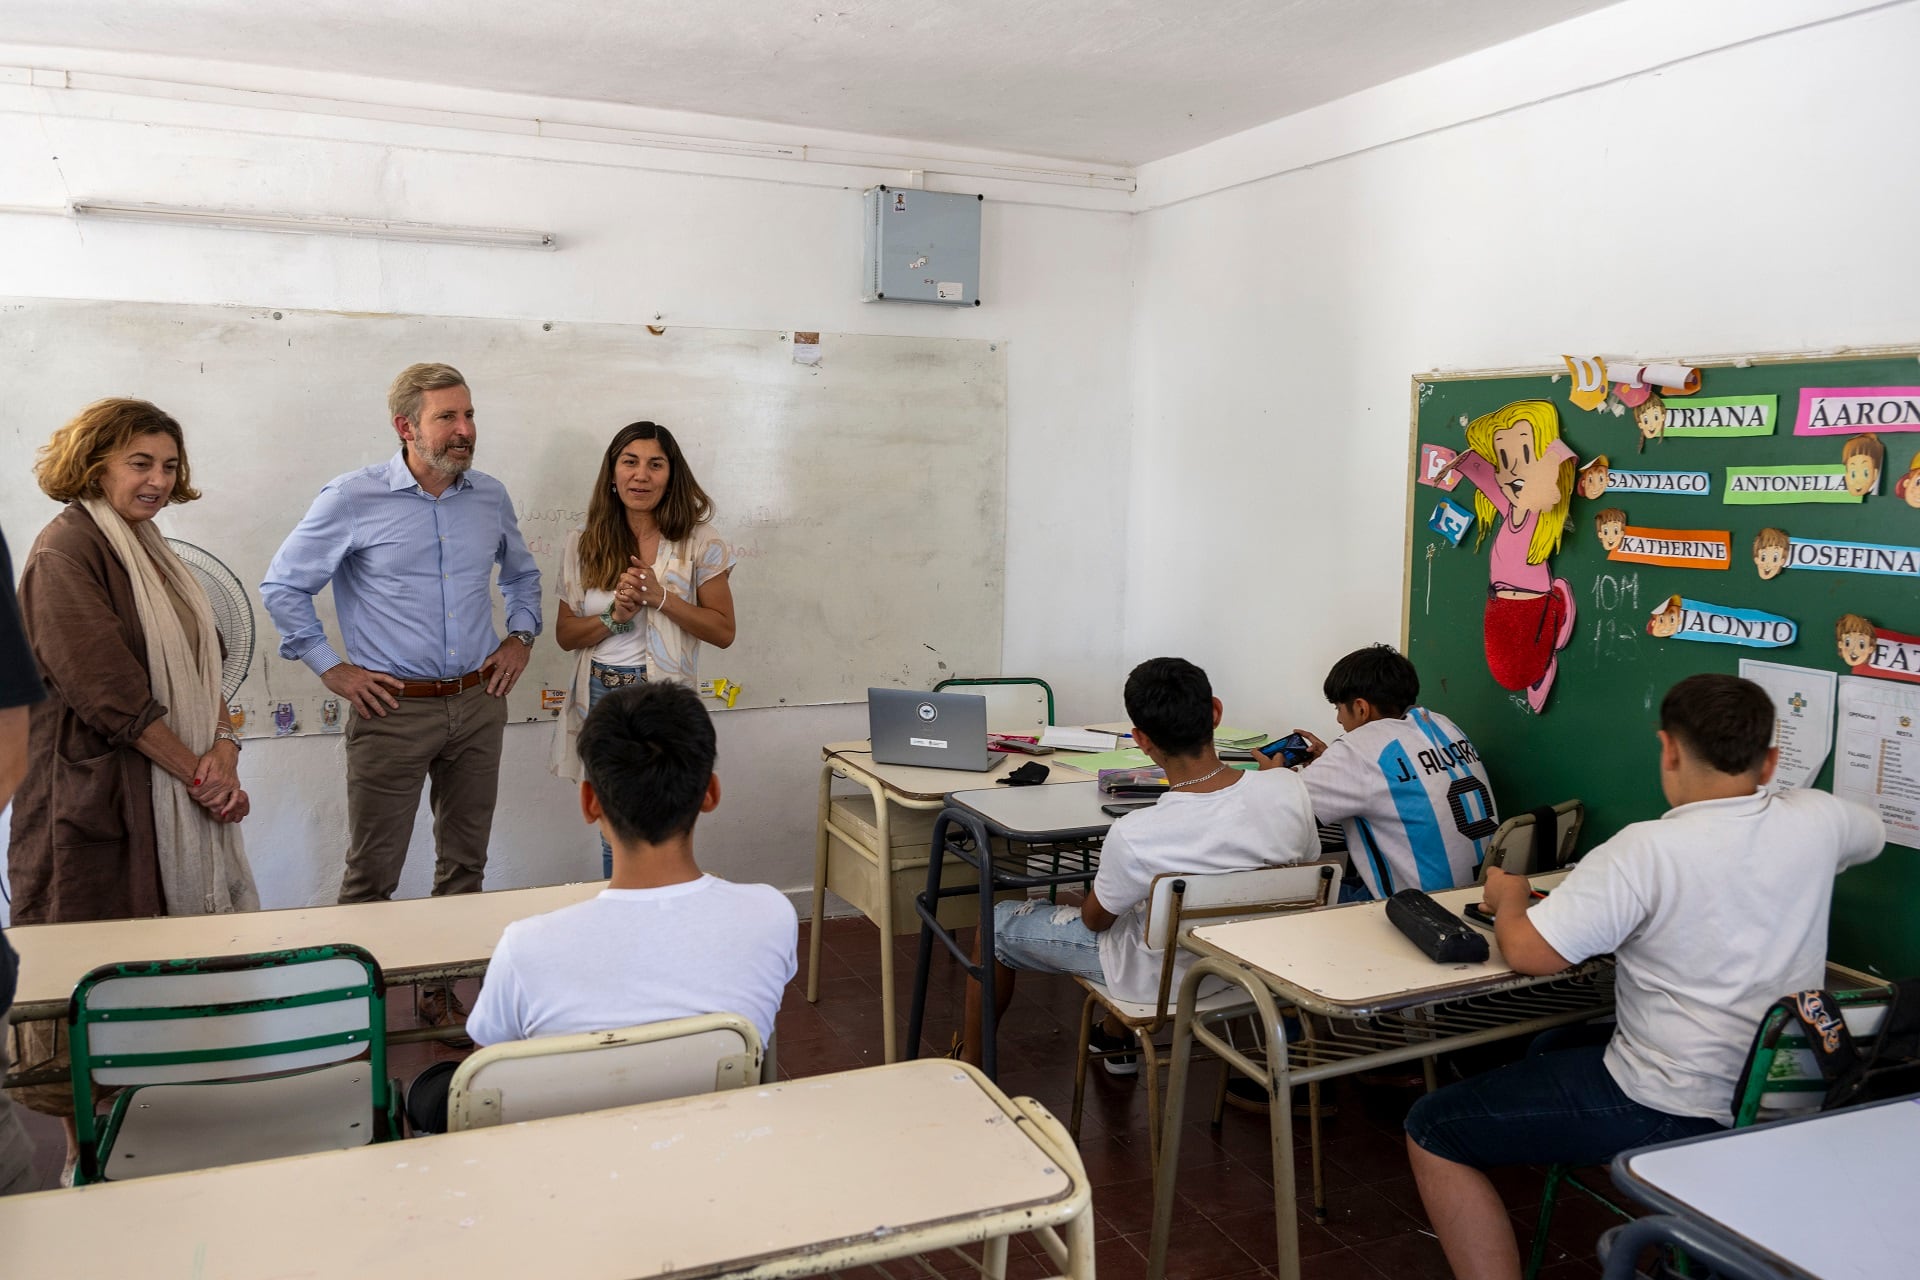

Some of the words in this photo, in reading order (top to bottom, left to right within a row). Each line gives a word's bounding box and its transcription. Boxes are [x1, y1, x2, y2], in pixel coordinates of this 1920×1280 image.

[1570, 356, 1602, 392] D
[1665, 405, 1765, 428] TRIANA
[1808, 398, 1920, 428] ÁARON
[1607, 472, 1707, 492] SANTIAGO
[1731, 475, 1849, 492] ANTONELLA
[1620, 537, 1726, 559] KATHERINE
[1785, 543, 1918, 573] JOSEFINA
[1678, 608, 1794, 643] JACINTO
[1397, 757, 1417, 783] J.
[1447, 775, 1499, 841] 9
